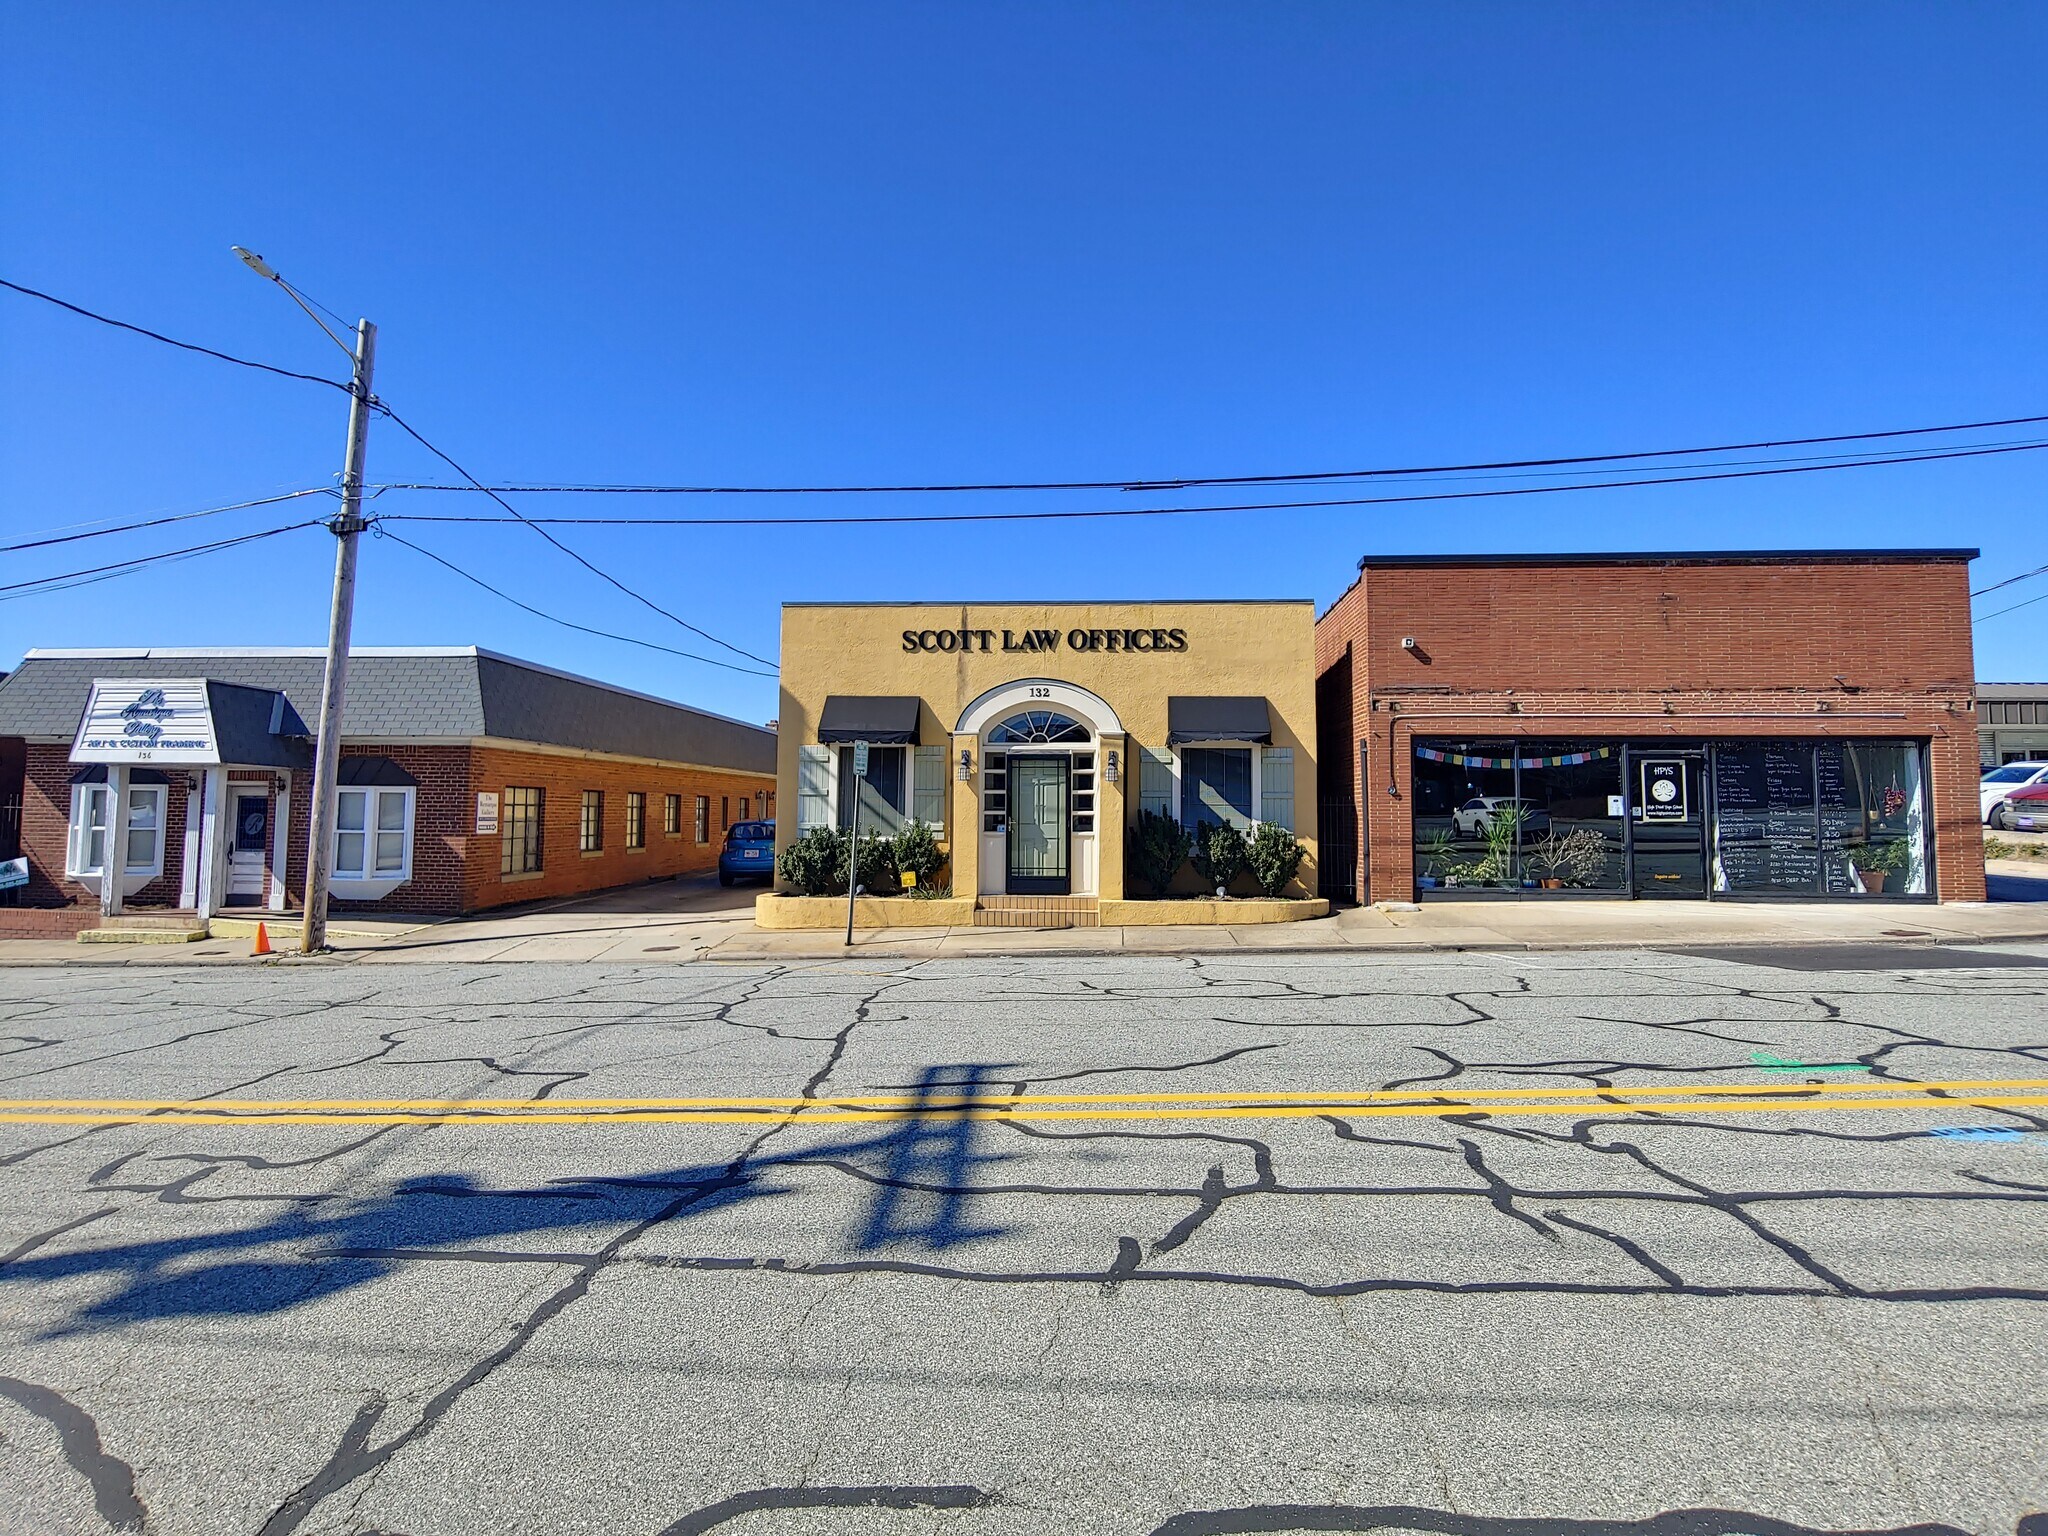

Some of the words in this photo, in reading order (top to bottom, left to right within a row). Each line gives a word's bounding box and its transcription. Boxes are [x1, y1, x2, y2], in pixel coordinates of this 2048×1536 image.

[902, 630, 996, 652] SCOTT
[1001, 630, 1059, 651] LAW
[1067, 629, 1187, 651] OFFICES
[138, 689, 165, 706] The
[1029, 688, 1050, 698] 132
[123, 721, 162, 740] Gallery
[108, 740, 117, 748] &
[120, 740, 158, 748] CUSTOM
[161, 740, 206, 748] FRAMING
[138, 751, 152, 759] 136
[1654, 766, 1674, 775] HPYS
